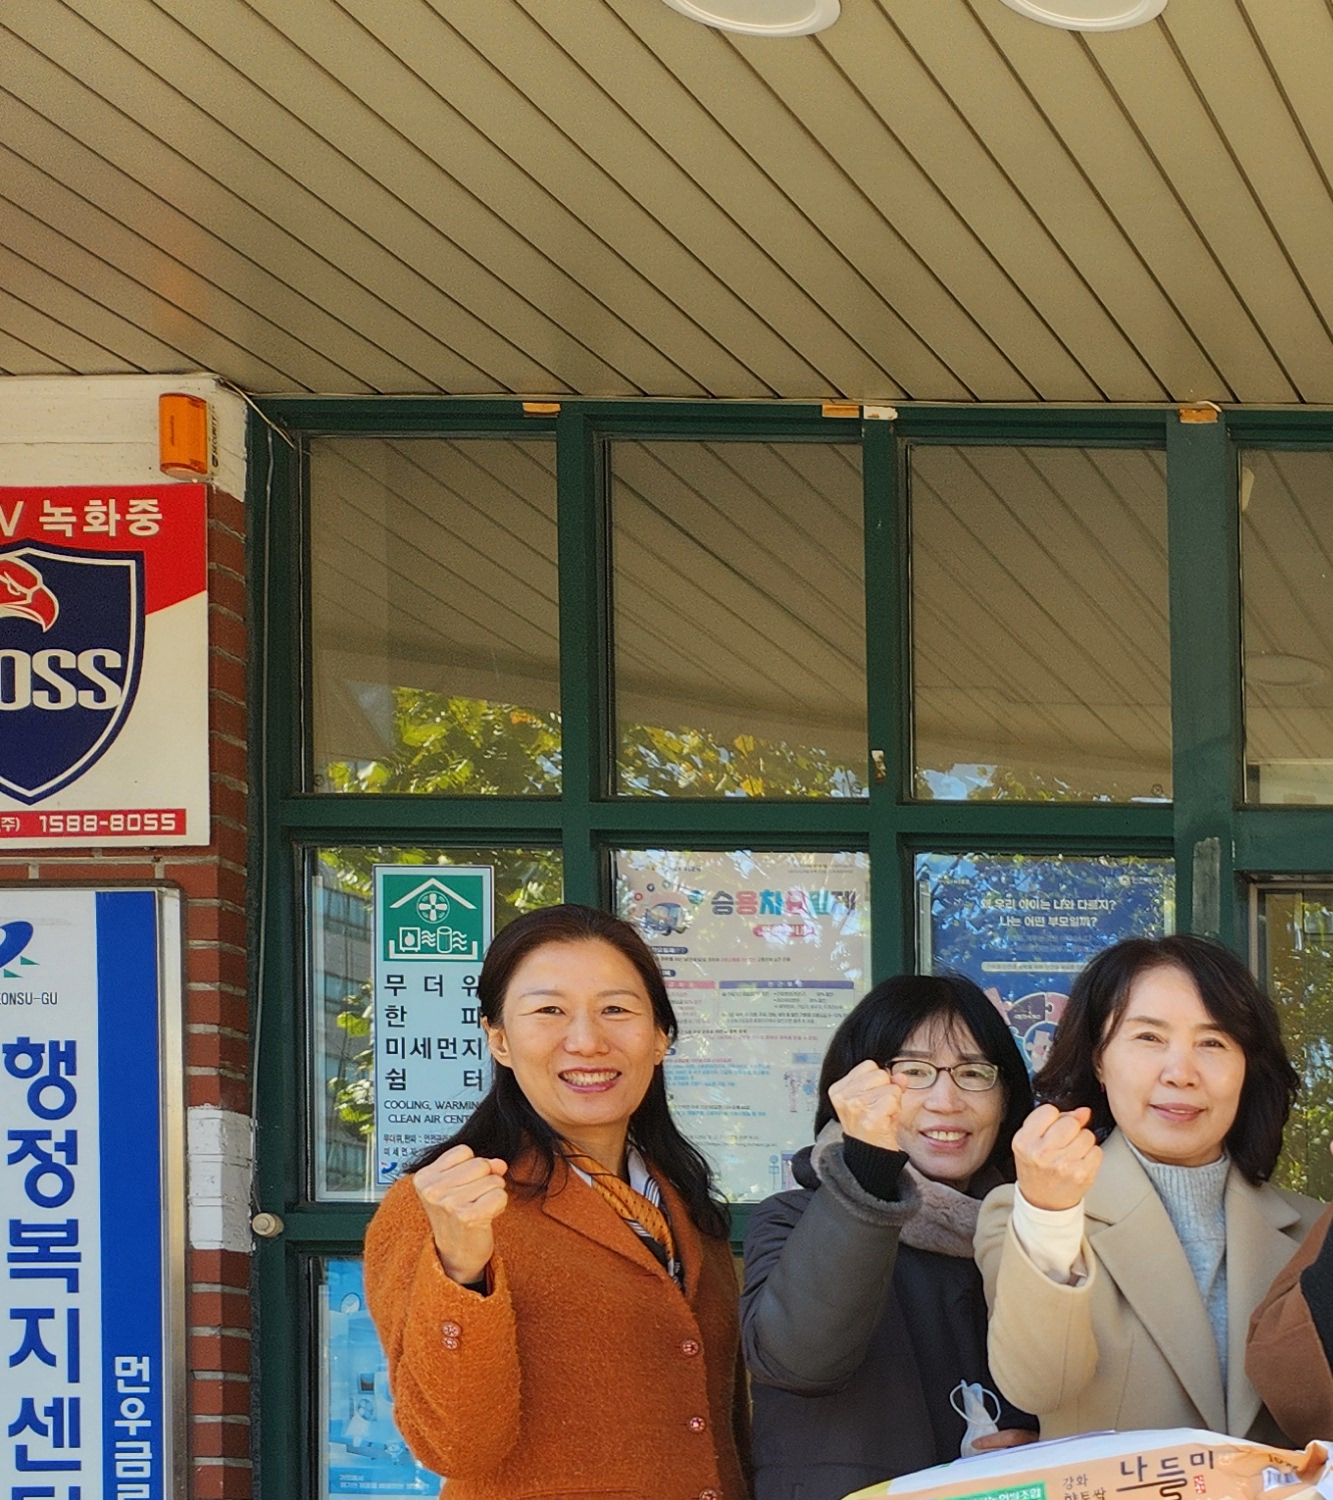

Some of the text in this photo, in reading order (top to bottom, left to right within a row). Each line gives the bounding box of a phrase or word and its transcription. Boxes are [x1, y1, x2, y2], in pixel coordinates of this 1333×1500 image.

[39, 499, 162, 537] 녹화중
[39, 814, 176, 832] 1588-8055
[995, 899, 1015, 910] 우리
[1018, 899, 1050, 910] 아이는
[1000, 916, 1098, 928] 나는 어떤 부모일까?
[386, 1037, 482, 1060] 미세먼지
[384, 1100, 480, 1111] COOLING, WARMIN
[388, 1114, 471, 1124] CLEAN AIR CENT
